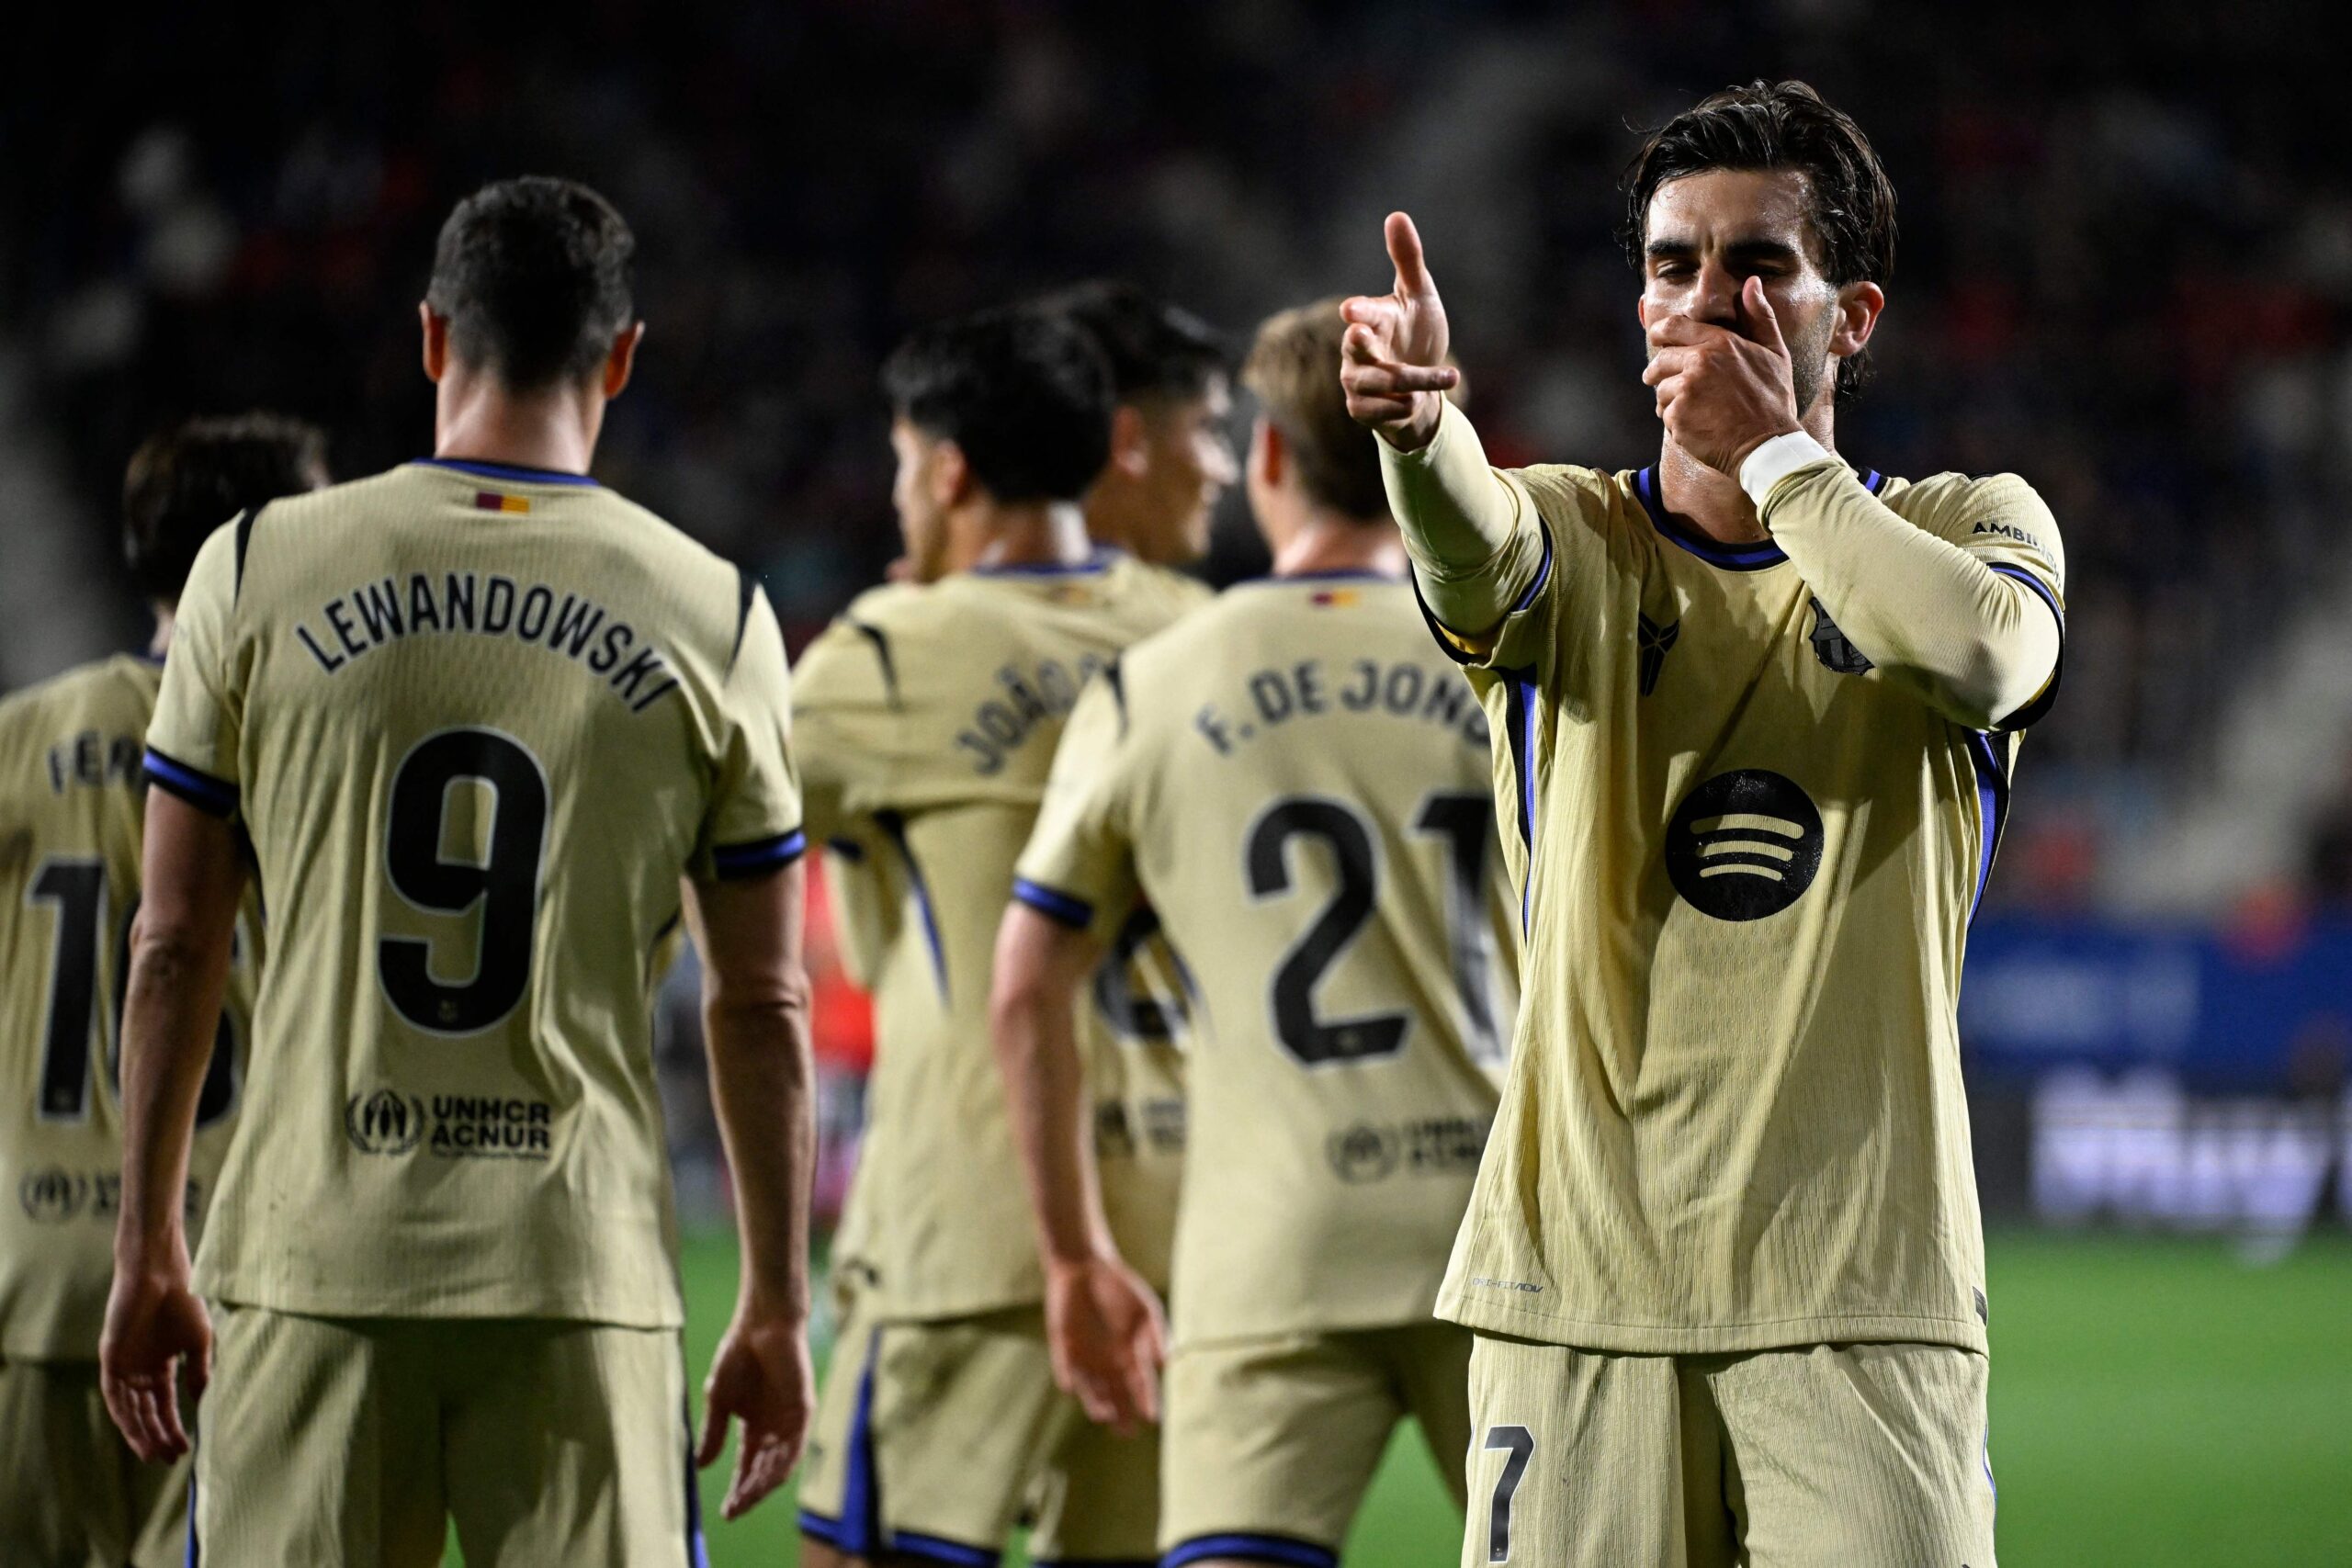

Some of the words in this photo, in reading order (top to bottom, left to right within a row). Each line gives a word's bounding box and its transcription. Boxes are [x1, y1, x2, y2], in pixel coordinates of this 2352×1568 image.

[295, 572, 680, 713] LEWANDOWSKI
[1247, 659, 1327, 727] DE
[377, 725, 549, 1036] 9
[1245, 790, 1504, 1071] 21
[430, 1122, 550, 1149] ACNUR
[432, 1093, 550, 1125] UNHCR
[1484, 1426, 1535, 1563] 7
